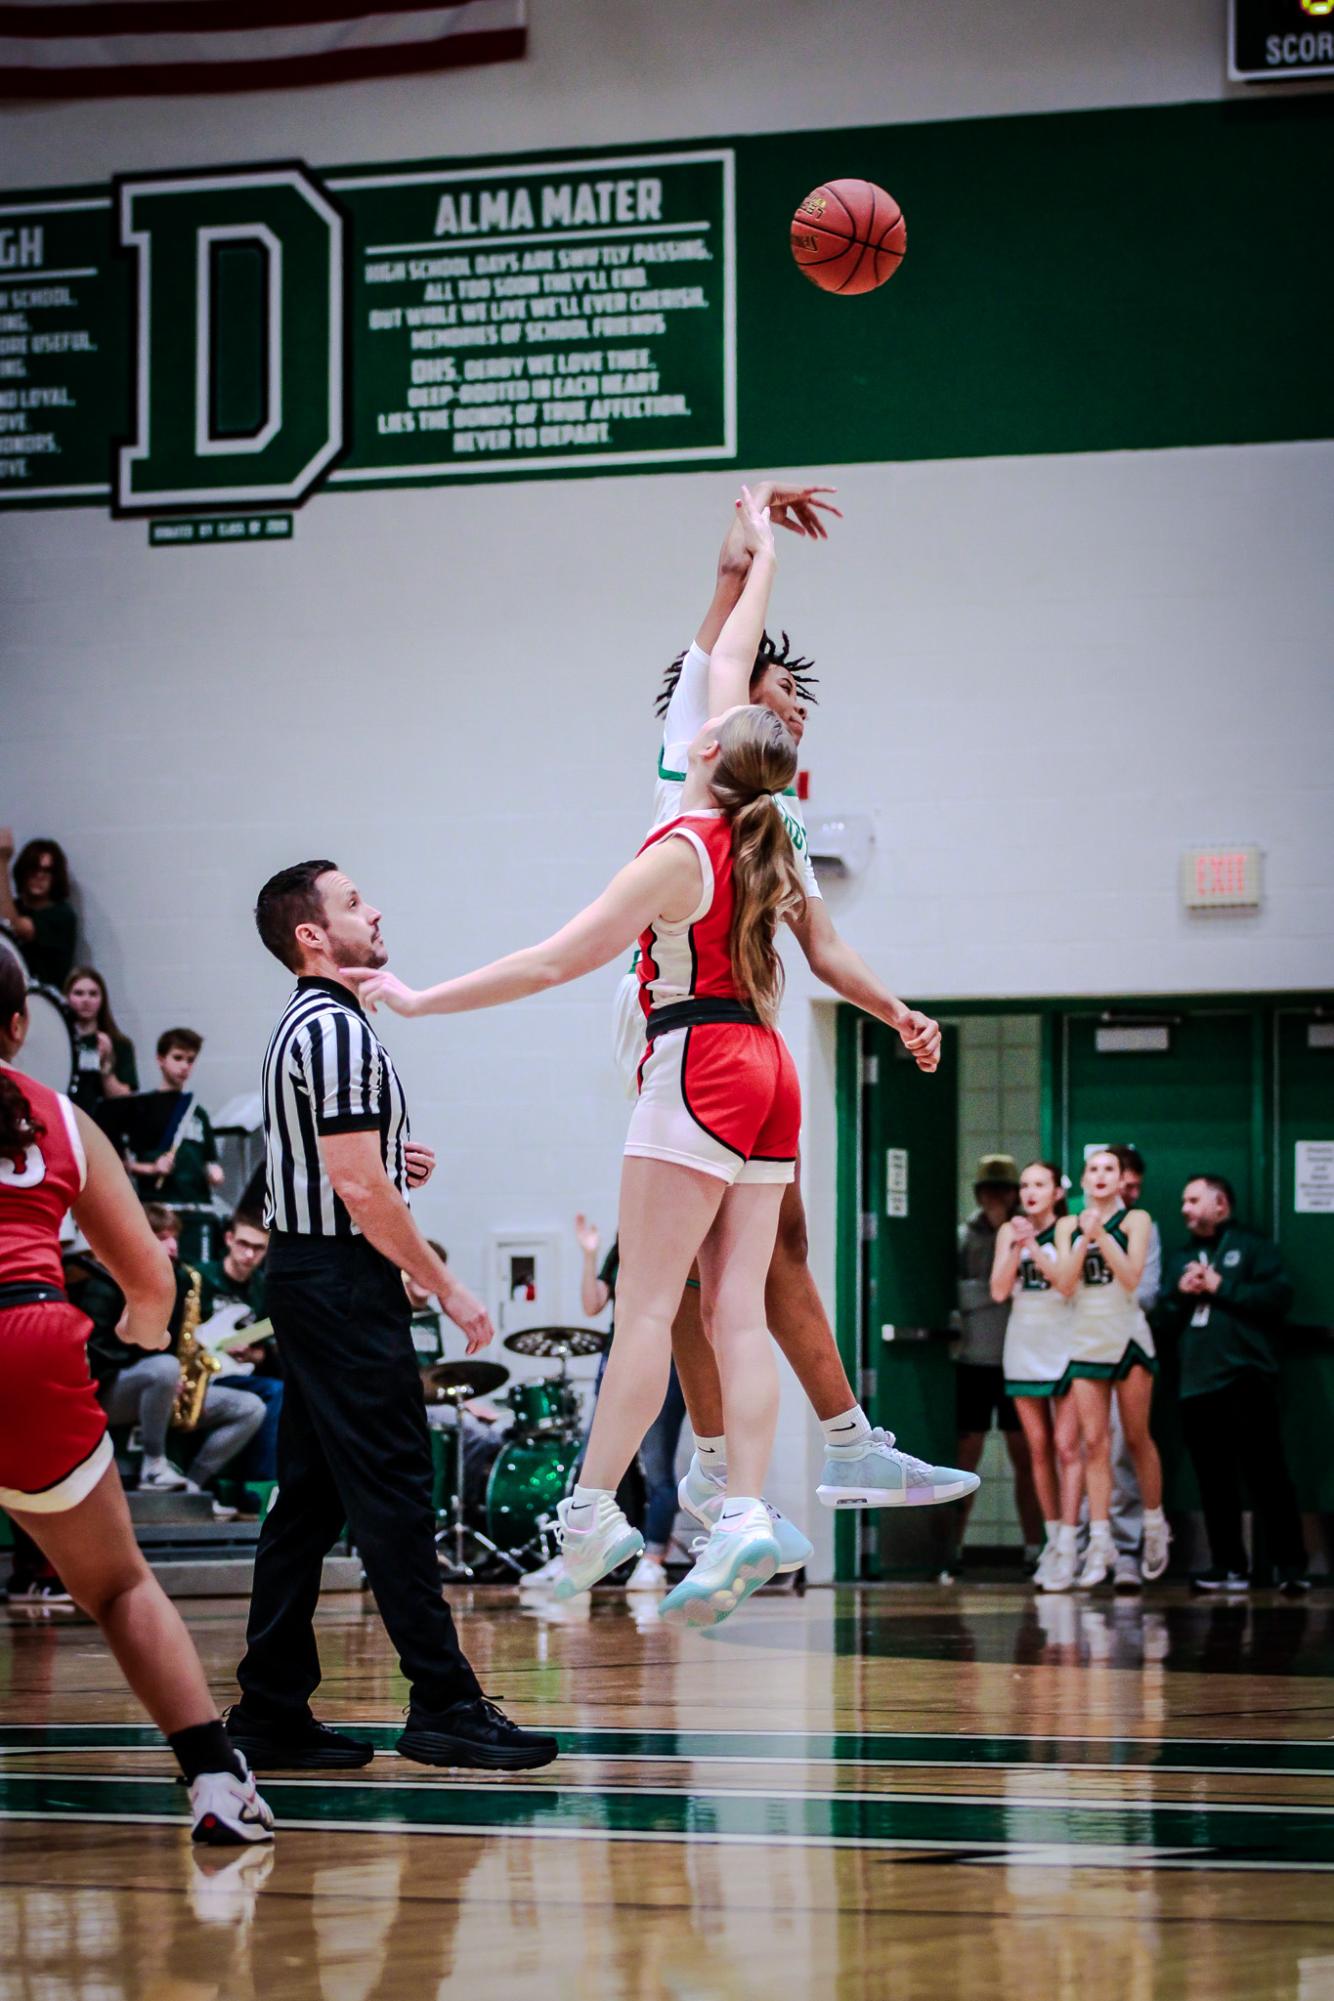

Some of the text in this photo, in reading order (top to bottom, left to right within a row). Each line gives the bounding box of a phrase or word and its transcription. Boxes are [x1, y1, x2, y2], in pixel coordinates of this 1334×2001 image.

[436, 179, 661, 234] ALMA MATER
[117, 167, 344, 511] D
[1196, 853, 1247, 896] EXIT
